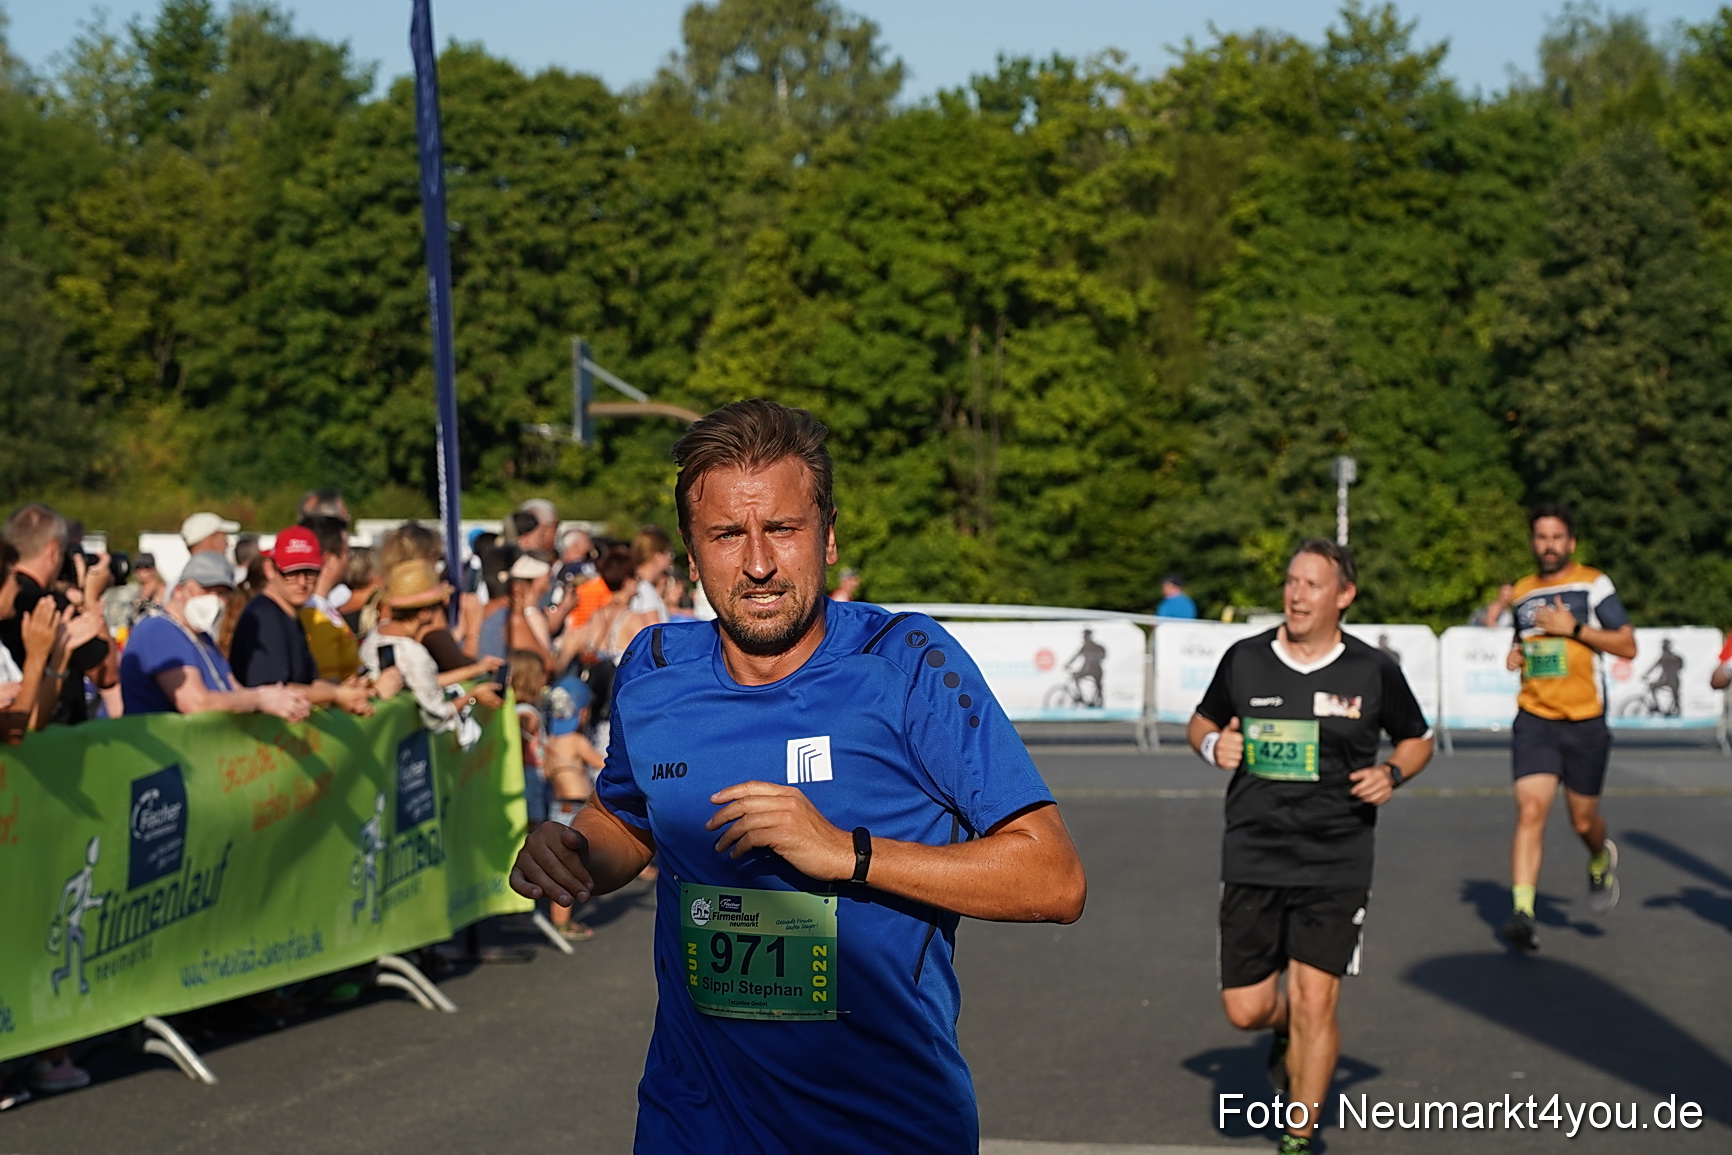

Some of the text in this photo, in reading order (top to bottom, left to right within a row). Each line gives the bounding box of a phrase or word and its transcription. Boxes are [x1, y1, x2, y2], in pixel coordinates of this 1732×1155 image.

[1259, 742, 1298, 760] 423
[651, 762, 688, 780] JAKO
[712, 911, 760, 921] Firmenlauf
[729, 920, 759, 928] neumarkt
[688, 942, 698, 987] RUN
[710, 932, 785, 978] 971
[812, 945, 828, 1003] 2022
[702, 976, 803, 999] Sippl Stephan
